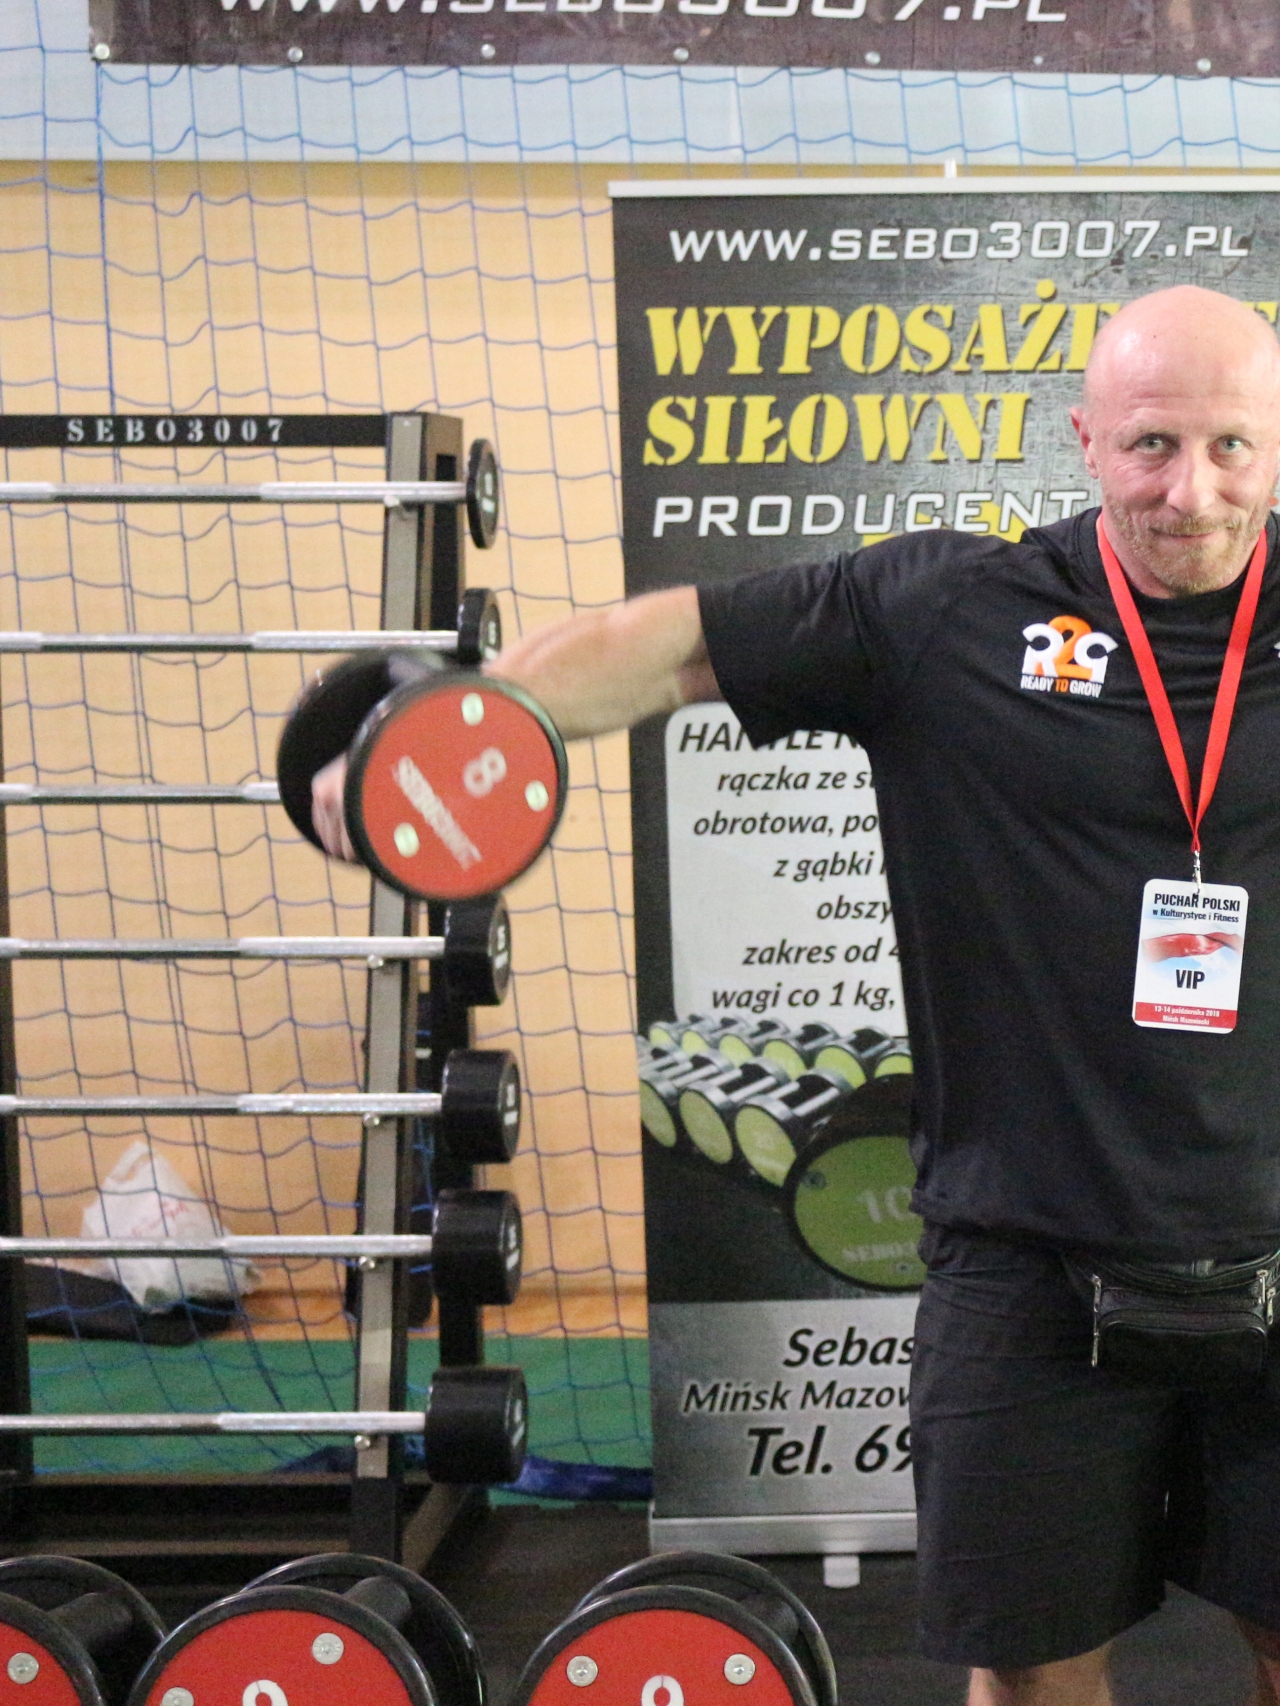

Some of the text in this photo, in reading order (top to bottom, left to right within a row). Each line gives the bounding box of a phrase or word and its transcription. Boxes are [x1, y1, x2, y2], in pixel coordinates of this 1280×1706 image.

[669, 220, 1249, 262] WWW.SEBO3007.PL
[67, 418, 284, 443] SEBO3007
[642, 392, 1030, 466] SIŁOWNI
[1020, 675, 1102, 698] READY TO GROW
[717, 766, 810, 796] rączka
[816, 770, 846, 790] ze
[693, 811, 834, 836] obrotowa,
[773, 859, 788, 877] z
[793, 851, 874, 882] gąbki
[1154, 893, 1241, 911] PUCHAR POLSKI
[1160, 908, 1207, 920] Kulturystyce
[1213, 912, 1239, 922] Fitness
[742, 939, 837, 966] zakres
[844, 937, 882, 963] od
[1176, 969, 1205, 989] VIP
[712, 983, 782, 1013] wagi
[788, 988, 820, 1008] co
[829, 981, 845, 1007] 1
[682, 1381, 791, 1413] Mińsk
[747, 1425, 833, 1477] Tel.
